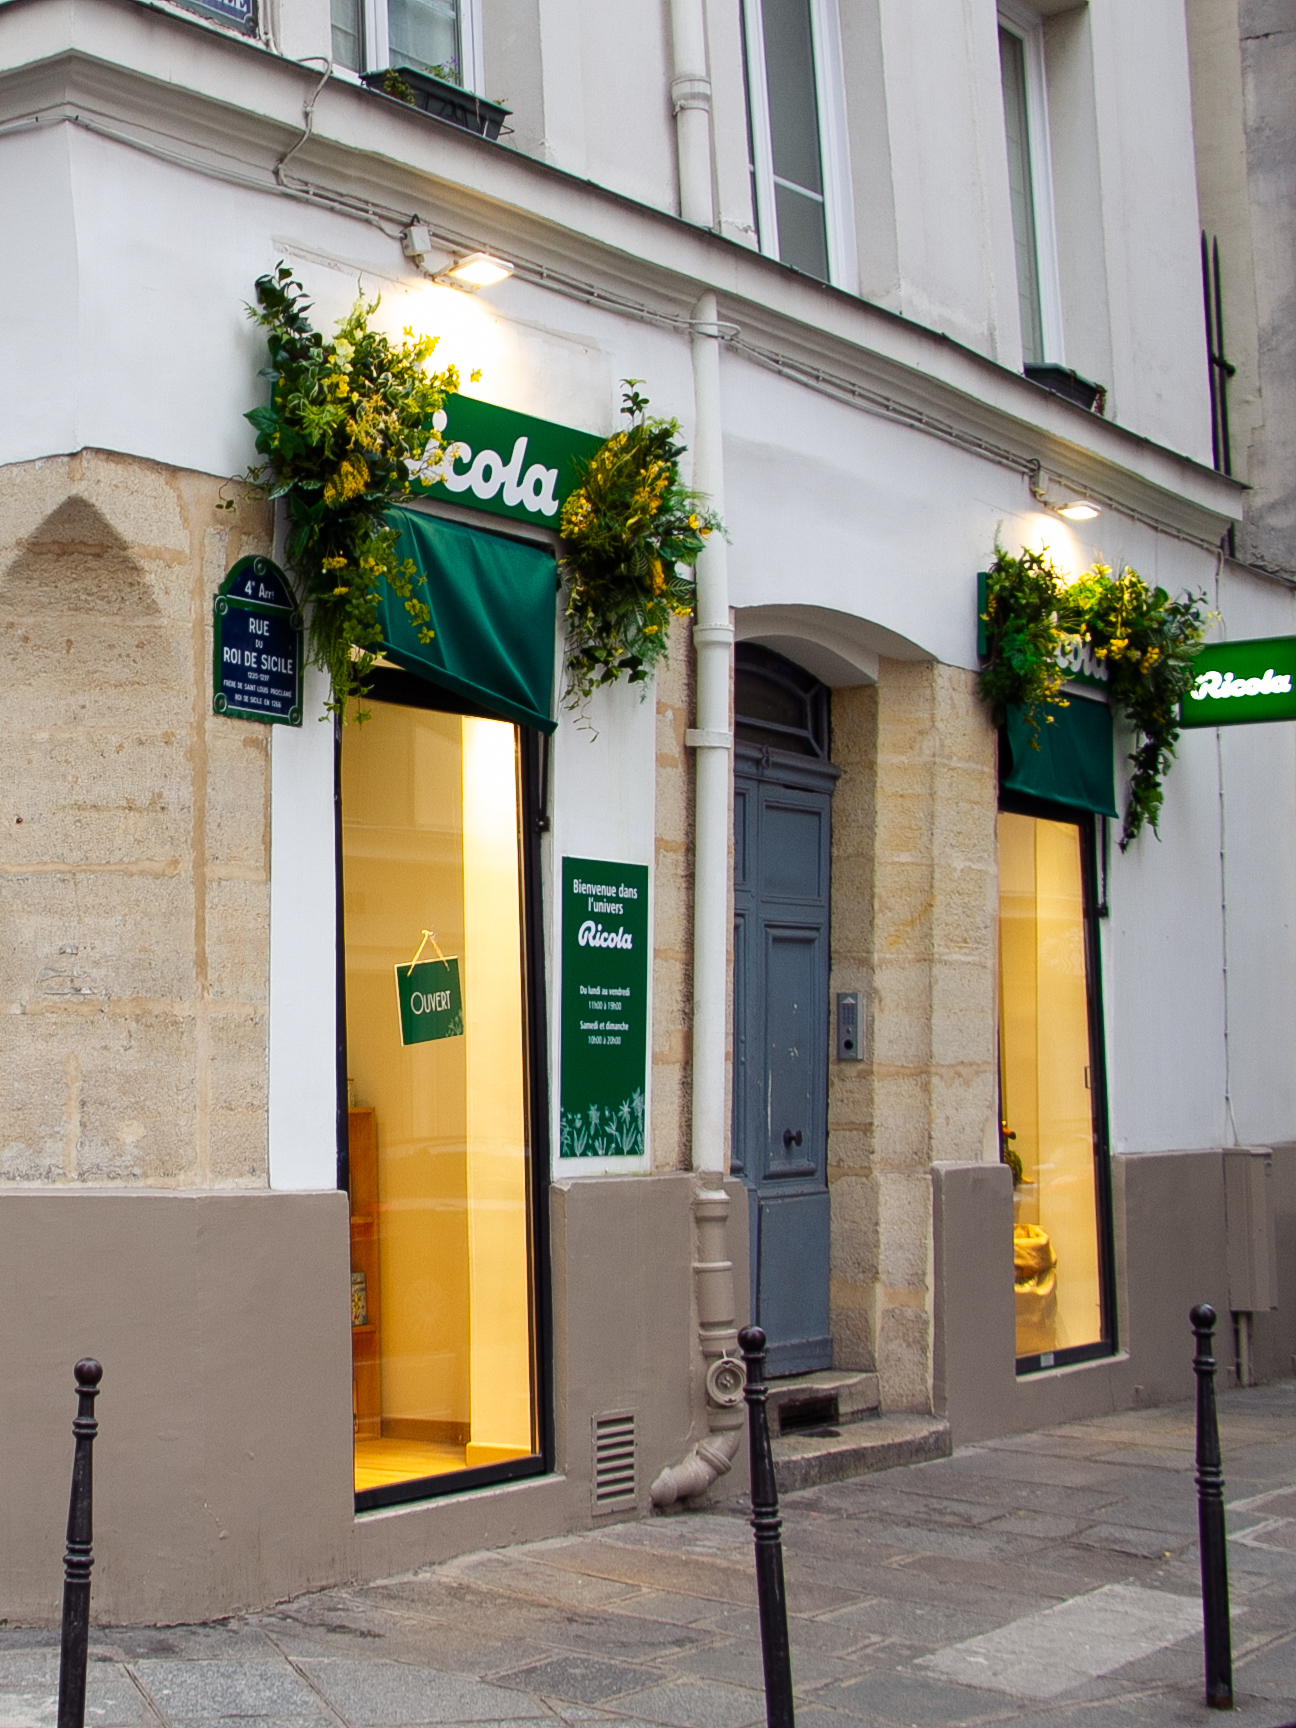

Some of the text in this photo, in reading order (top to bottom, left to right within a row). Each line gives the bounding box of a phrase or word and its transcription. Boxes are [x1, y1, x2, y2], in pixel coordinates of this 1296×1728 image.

[403, 408, 560, 517] icola
[249, 617, 270, 637] RUE
[255, 639, 264, 650] DU
[223, 646, 294, 675] ROI DE SICILE
[237, 681, 243, 689] DE
[244, 683, 256, 692] SAINT
[256, 685, 269, 694] LOUIS
[1190, 668, 1294, 700] Ricola
[234, 693, 242, 701] ROI
[243, 695, 249, 703] DE
[249, 696, 263, 705] SICILE
[264, 698, 270, 706] EN
[573, 879, 638, 899] Bienvenue dans
[588, 896, 624, 915] l'univers
[578, 920, 633, 949] Ricola
[579, 985, 587, 995] Du
[588, 985, 601, 995] lundi
[609, 987, 630, 996] vendredi
[410, 990, 451, 1015] OUVERT
[579, 1020, 629, 1031] Samedi et dimanche
